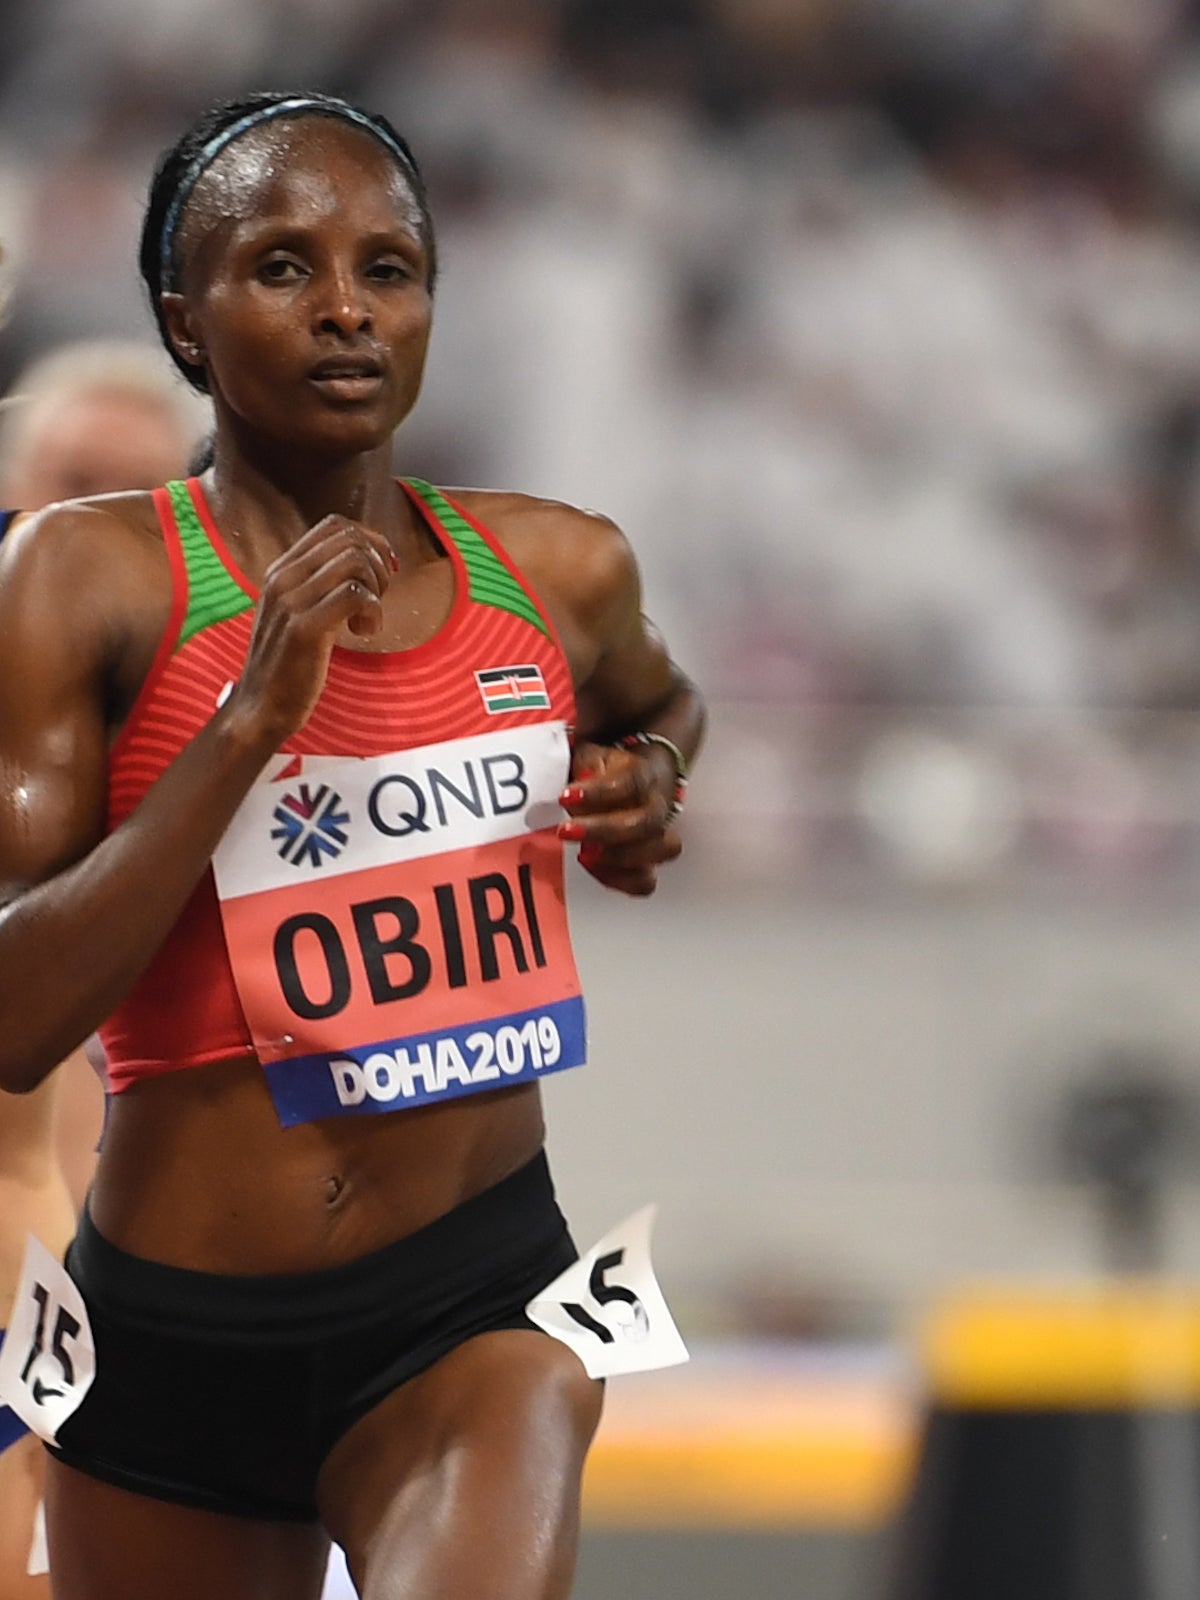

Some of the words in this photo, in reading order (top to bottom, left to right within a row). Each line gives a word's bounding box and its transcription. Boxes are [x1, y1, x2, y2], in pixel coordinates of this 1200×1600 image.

[367, 753, 528, 837] QNB
[273, 864, 547, 1020] OBIRI
[329, 1016, 560, 1107] DOHA2019
[20, 1281, 81, 1406] 15
[560, 1247, 649, 1344] 15
